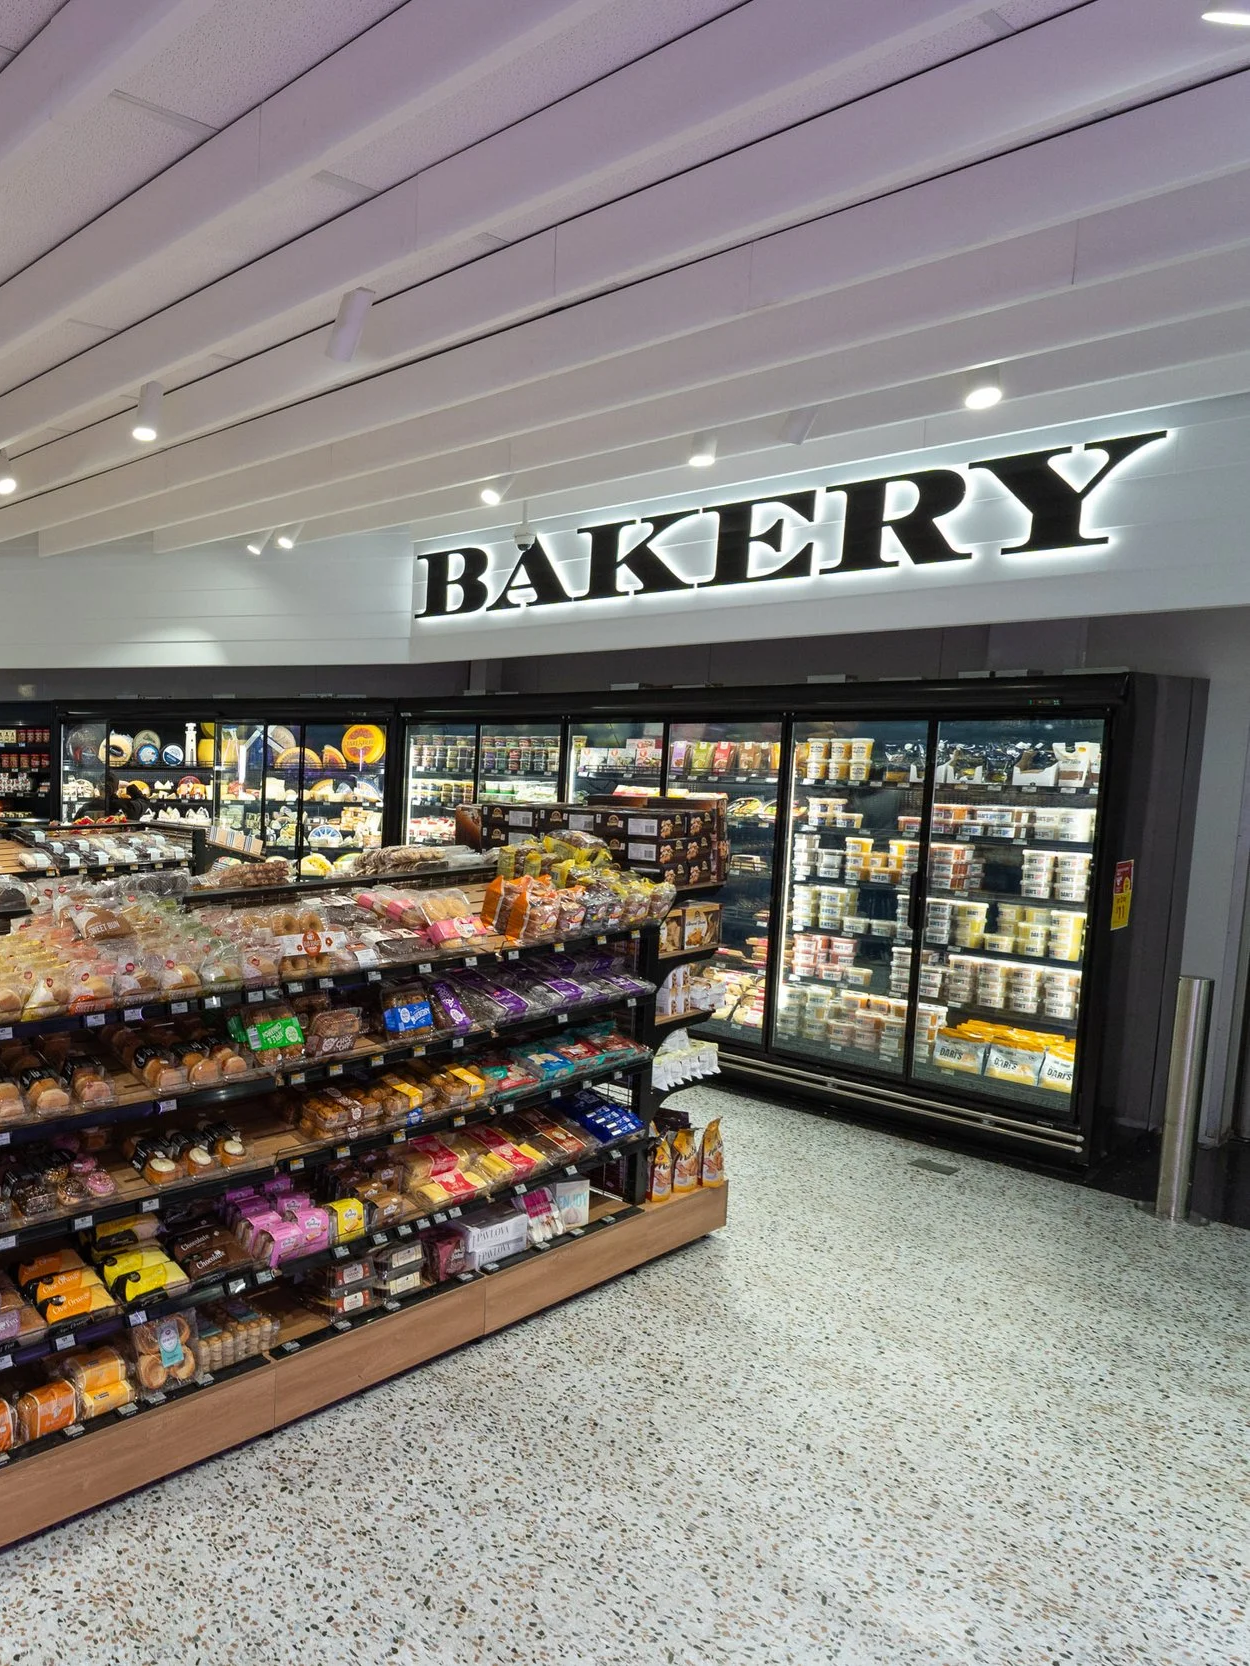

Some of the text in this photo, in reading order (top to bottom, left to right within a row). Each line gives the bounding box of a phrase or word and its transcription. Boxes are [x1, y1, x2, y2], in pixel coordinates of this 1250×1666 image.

[415, 430, 1169, 619] BAKERY
[86, 922, 108, 935] SWEET
[939, 1047, 964, 1060] DARI'S
[1046, 1067, 1072, 1081] DARI'S
[559, 1193, 588, 1209] ENJOY
[477, 1224, 510, 1243] PAVLOVA
[180, 1233, 210, 1252] Chocolate
[196, 1250, 226, 1270] Chocolate
